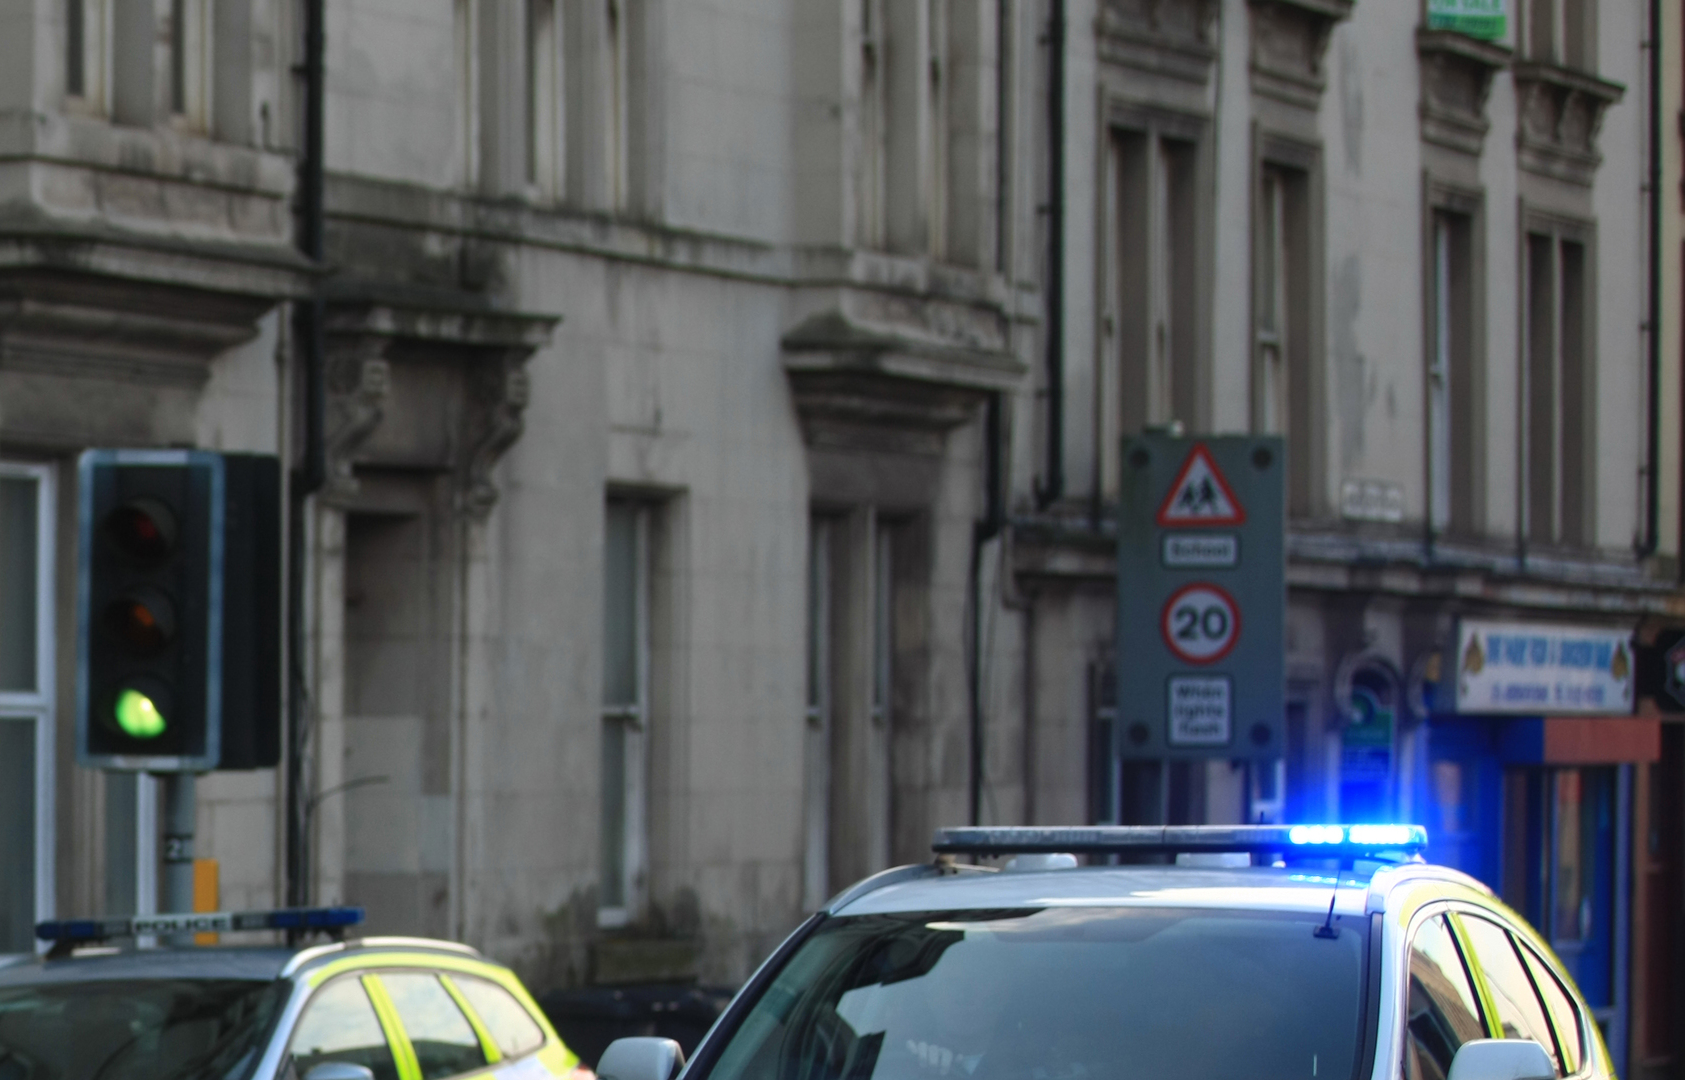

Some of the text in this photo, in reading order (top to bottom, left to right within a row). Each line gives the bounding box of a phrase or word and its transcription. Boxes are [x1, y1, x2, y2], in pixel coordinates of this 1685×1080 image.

[1172, 540, 1231, 557] School
[1175, 605, 1229, 640] 20
[1177, 684, 1222, 698] When
[1174, 703, 1223, 720] lights
[134, 917, 226, 931] POLICE
